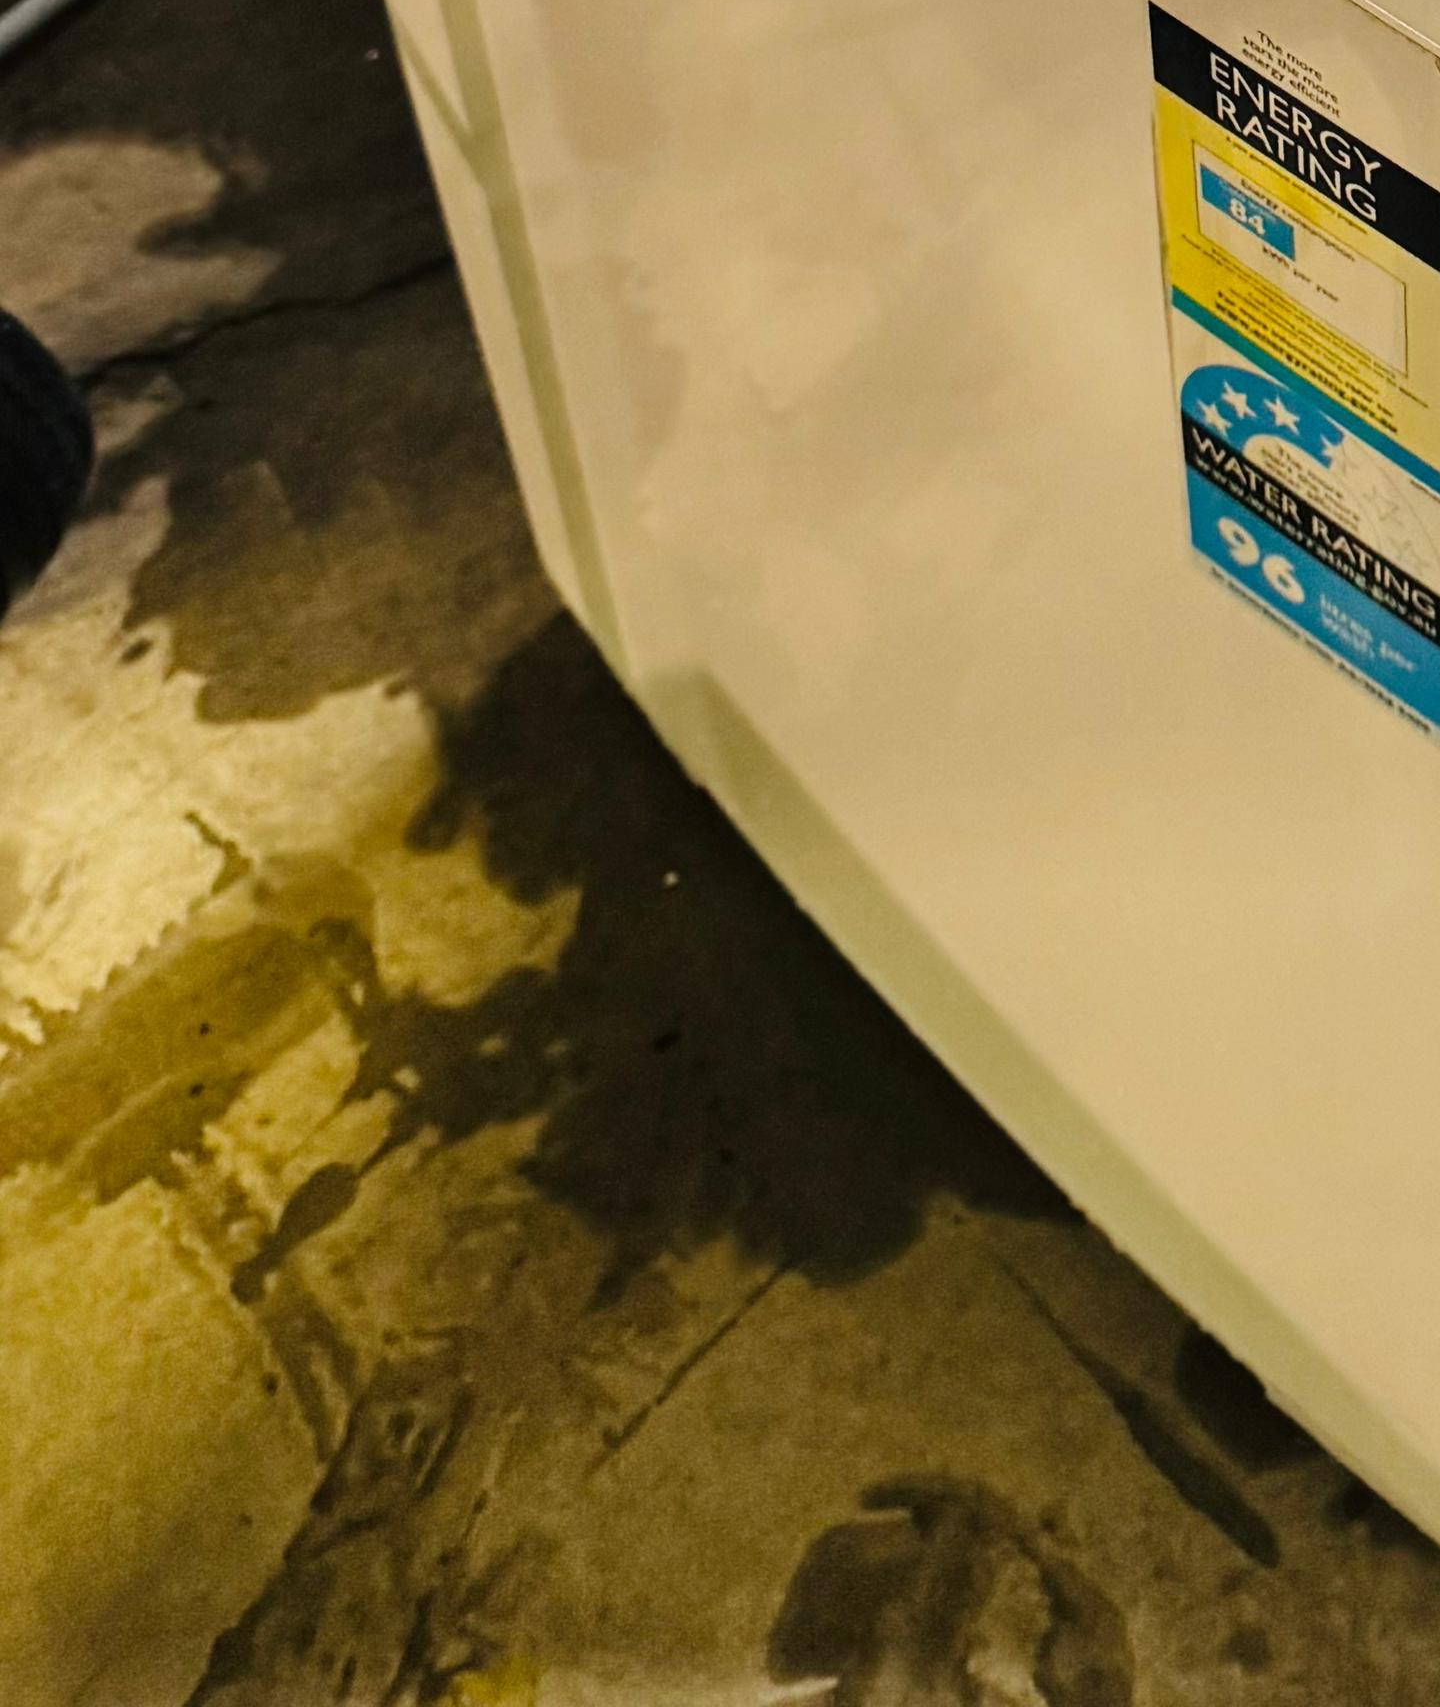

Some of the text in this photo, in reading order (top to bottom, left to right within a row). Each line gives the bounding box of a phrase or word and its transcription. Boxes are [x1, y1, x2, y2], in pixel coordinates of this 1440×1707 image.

[1242, 48, 1340, 118] energy efficient
[1243, 36, 1338, 104] stars the more
[1257, 30, 1322, 82] The more
[1210, 52, 1382, 184] ENERGY
[1216, 90, 1377, 221] RATING
[1229, 197, 1265, 236] 84
[1191, 426, 1435, 622] WATER RATING
[1217, 516, 1305, 604] 96
